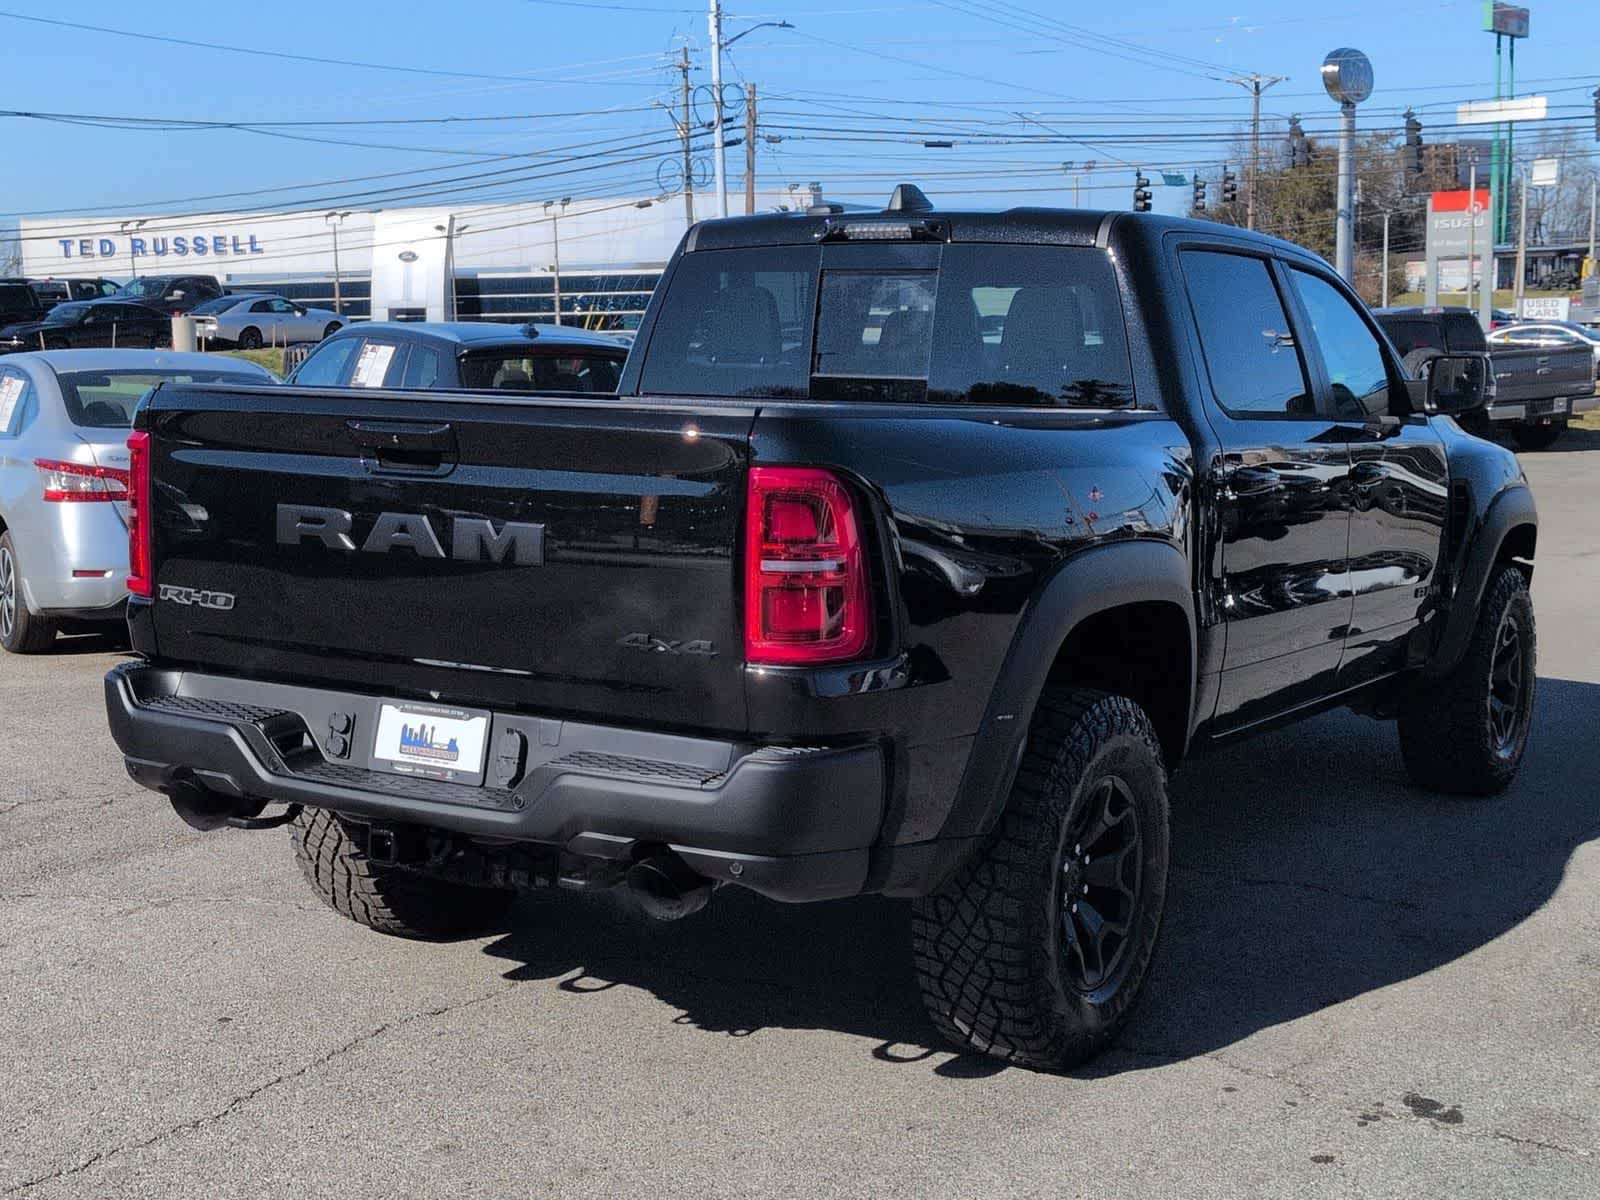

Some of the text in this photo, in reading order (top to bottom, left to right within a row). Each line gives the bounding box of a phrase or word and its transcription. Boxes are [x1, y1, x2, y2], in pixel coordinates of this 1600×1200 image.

[1433, 216, 1485, 230] ISUZU
[59, 234, 264, 258] TED RUSSELL
[1526, 299, 1560, 308] USED
[1526, 308, 1560, 318] CARS
[276, 503, 546, 567] RAM
[158, 583, 235, 610] RHO
